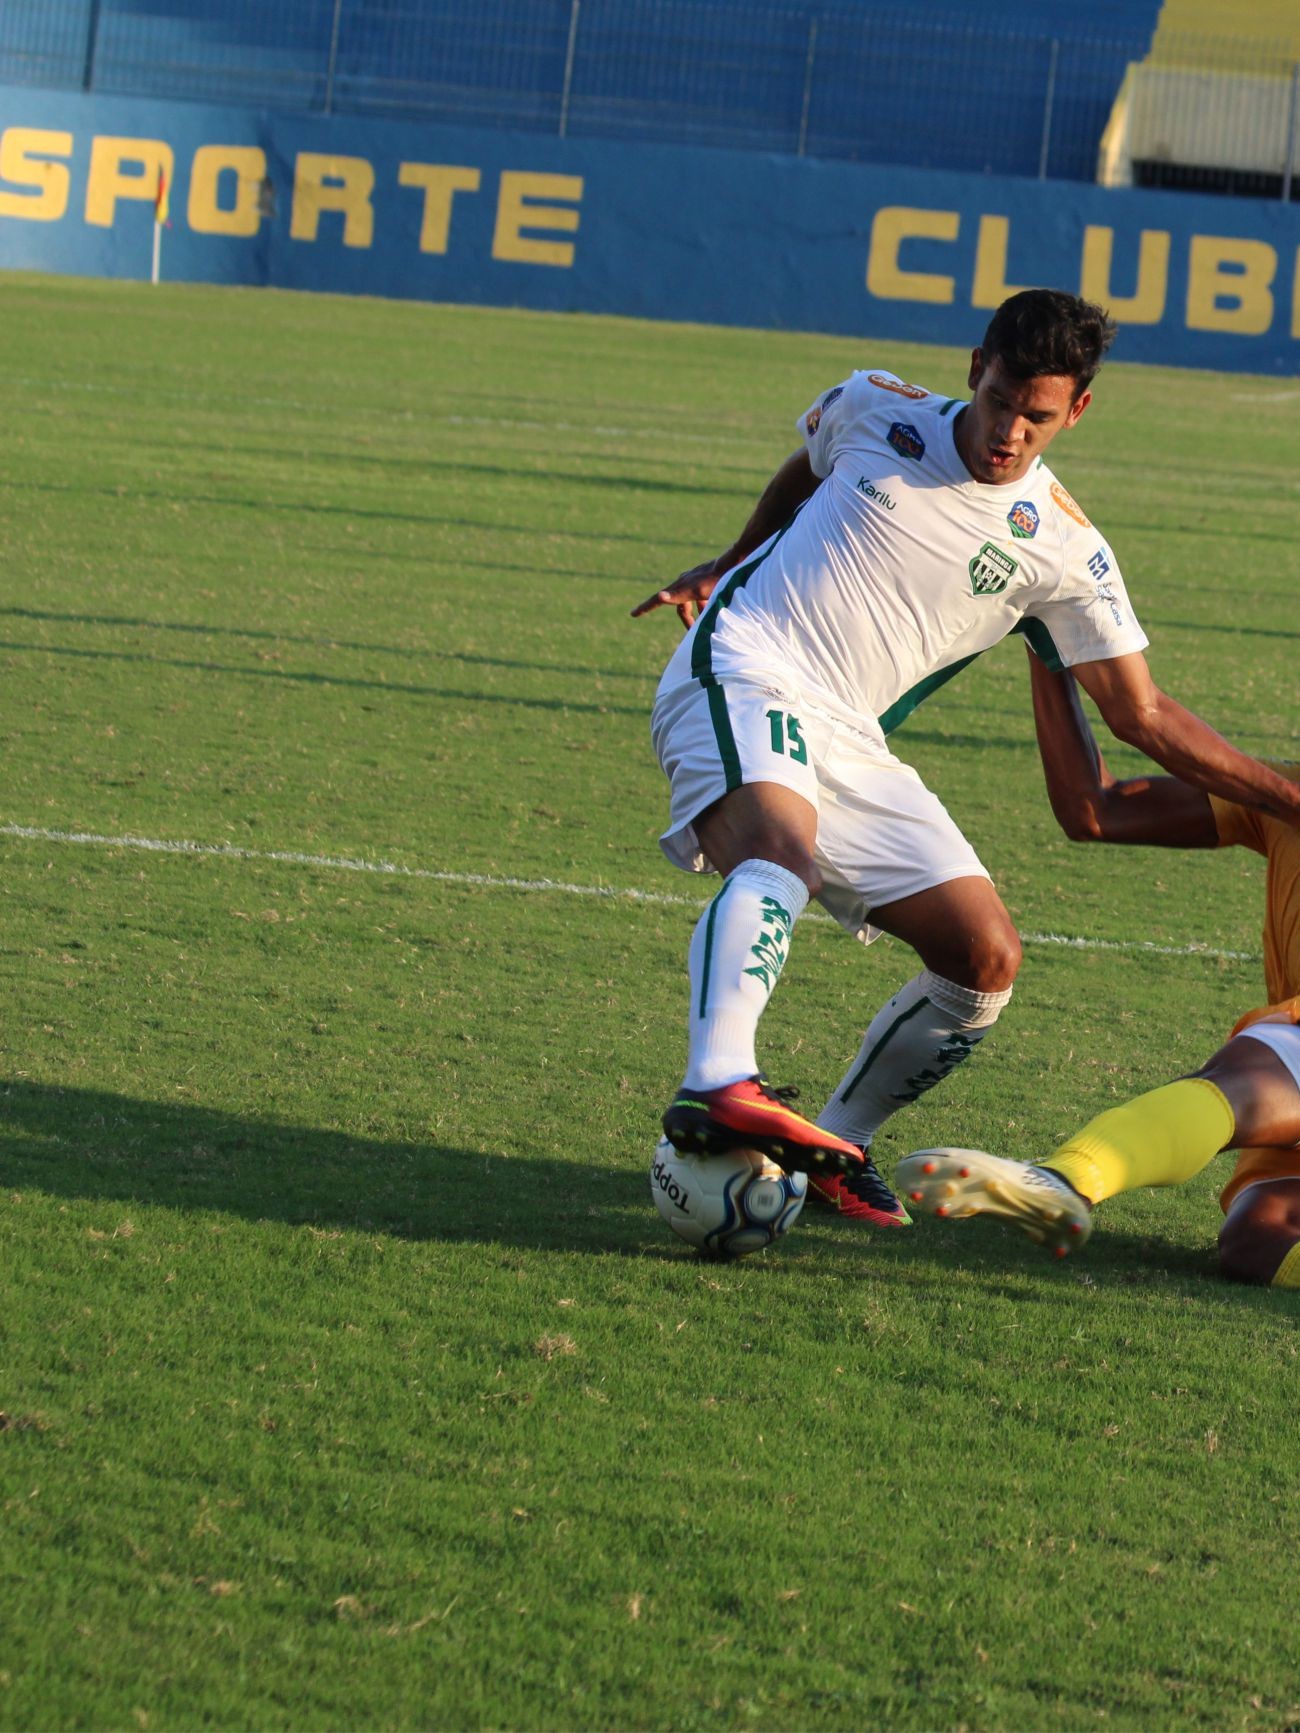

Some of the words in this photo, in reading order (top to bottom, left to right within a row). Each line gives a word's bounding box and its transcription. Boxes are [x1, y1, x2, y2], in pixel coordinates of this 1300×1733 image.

[0, 127, 584, 267] SPORTE
[1012, 509, 1034, 533] 100
[1016, 503, 1037, 523] AGRO
[766, 709, 808, 767] 15
[653, 1158, 690, 1214] Topp
